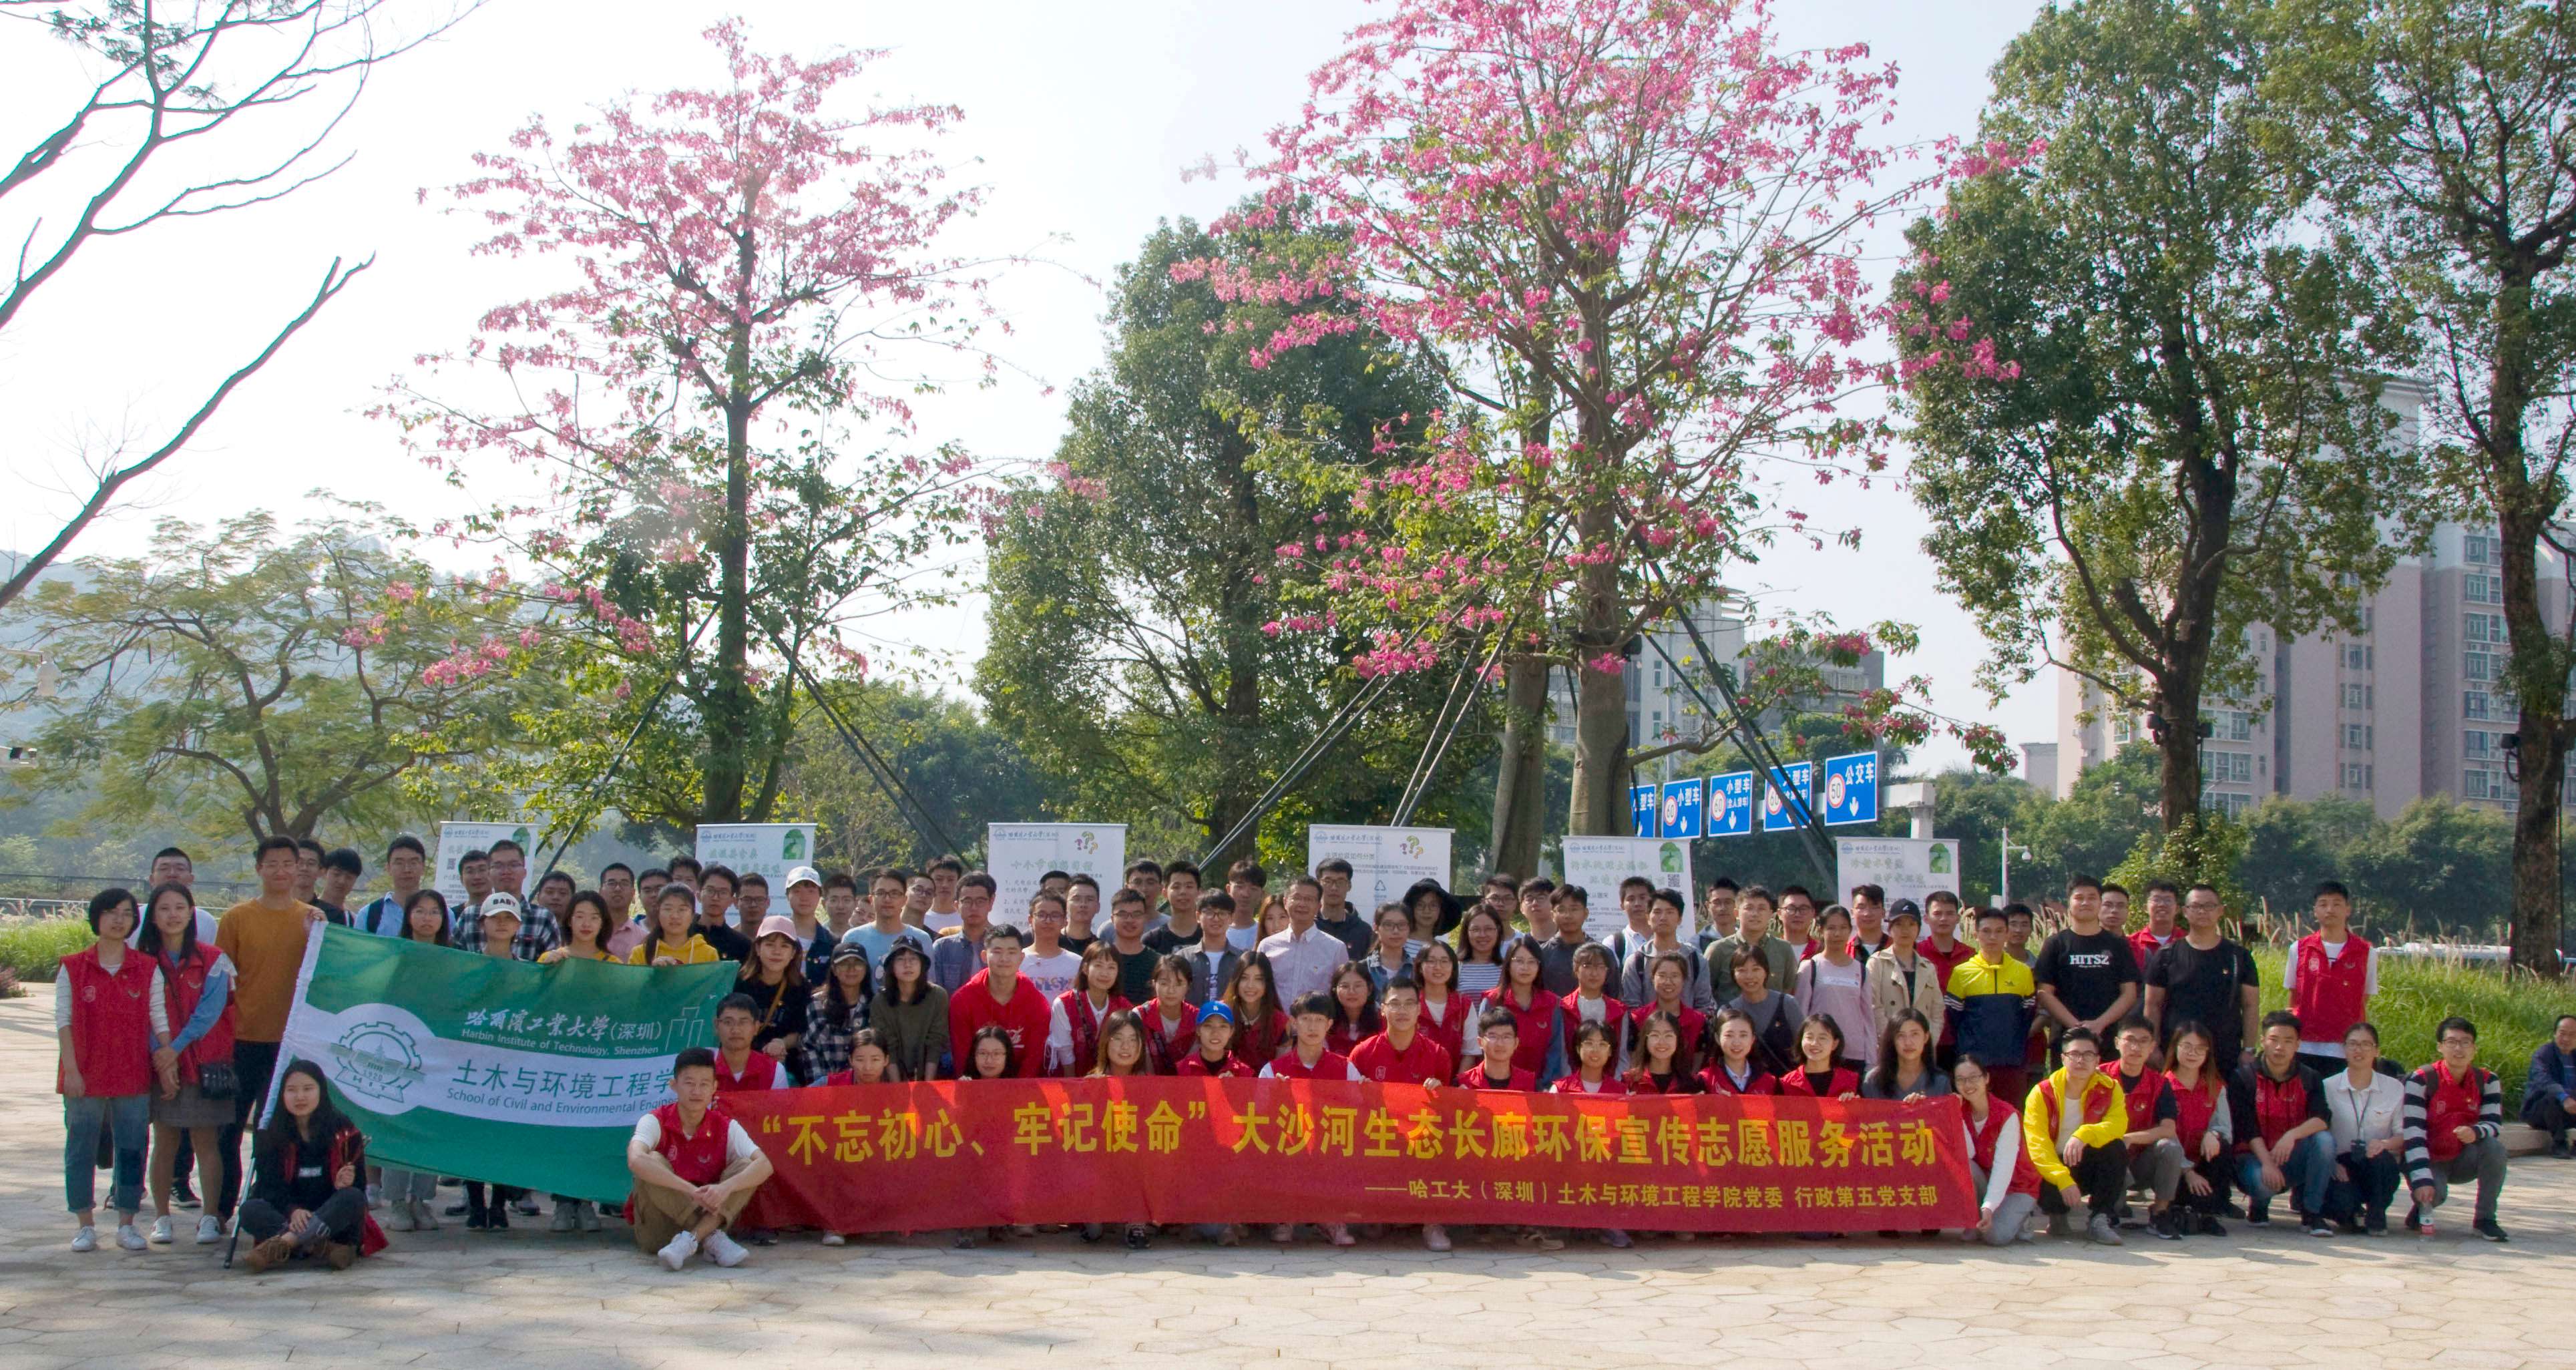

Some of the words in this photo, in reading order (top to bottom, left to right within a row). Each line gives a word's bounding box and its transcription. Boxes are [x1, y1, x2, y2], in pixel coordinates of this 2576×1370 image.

[1845, 761, 1874, 785] 公交车
[1726, 777, 1750, 794] 小型车
[1832, 784, 1842, 799] 50
[1677, 786, 1700, 807] 小型车
[1667, 803, 1674, 818] 60
[1715, 798, 1723, 813] 60
[493, 898, 515, 907] BABY
[2069, 953, 2109, 966] HITSZ
[461, 1028, 494, 1042] Harbin
[497, 1034, 536, 1048] Institute
[540, 1040, 551, 1050] of
[554, 1040, 610, 1057] Technology,
[614, 1046, 659, 1056] Shenzhen
[363, 1070, 383, 1082] 1920
[447, 1088, 485, 1104] School
[487, 1096, 501, 1107] of
[503, 1097, 527, 1110] Civil
[531, 1101, 554, 1113] and
[556, 1100, 635, 1114] Environmental
